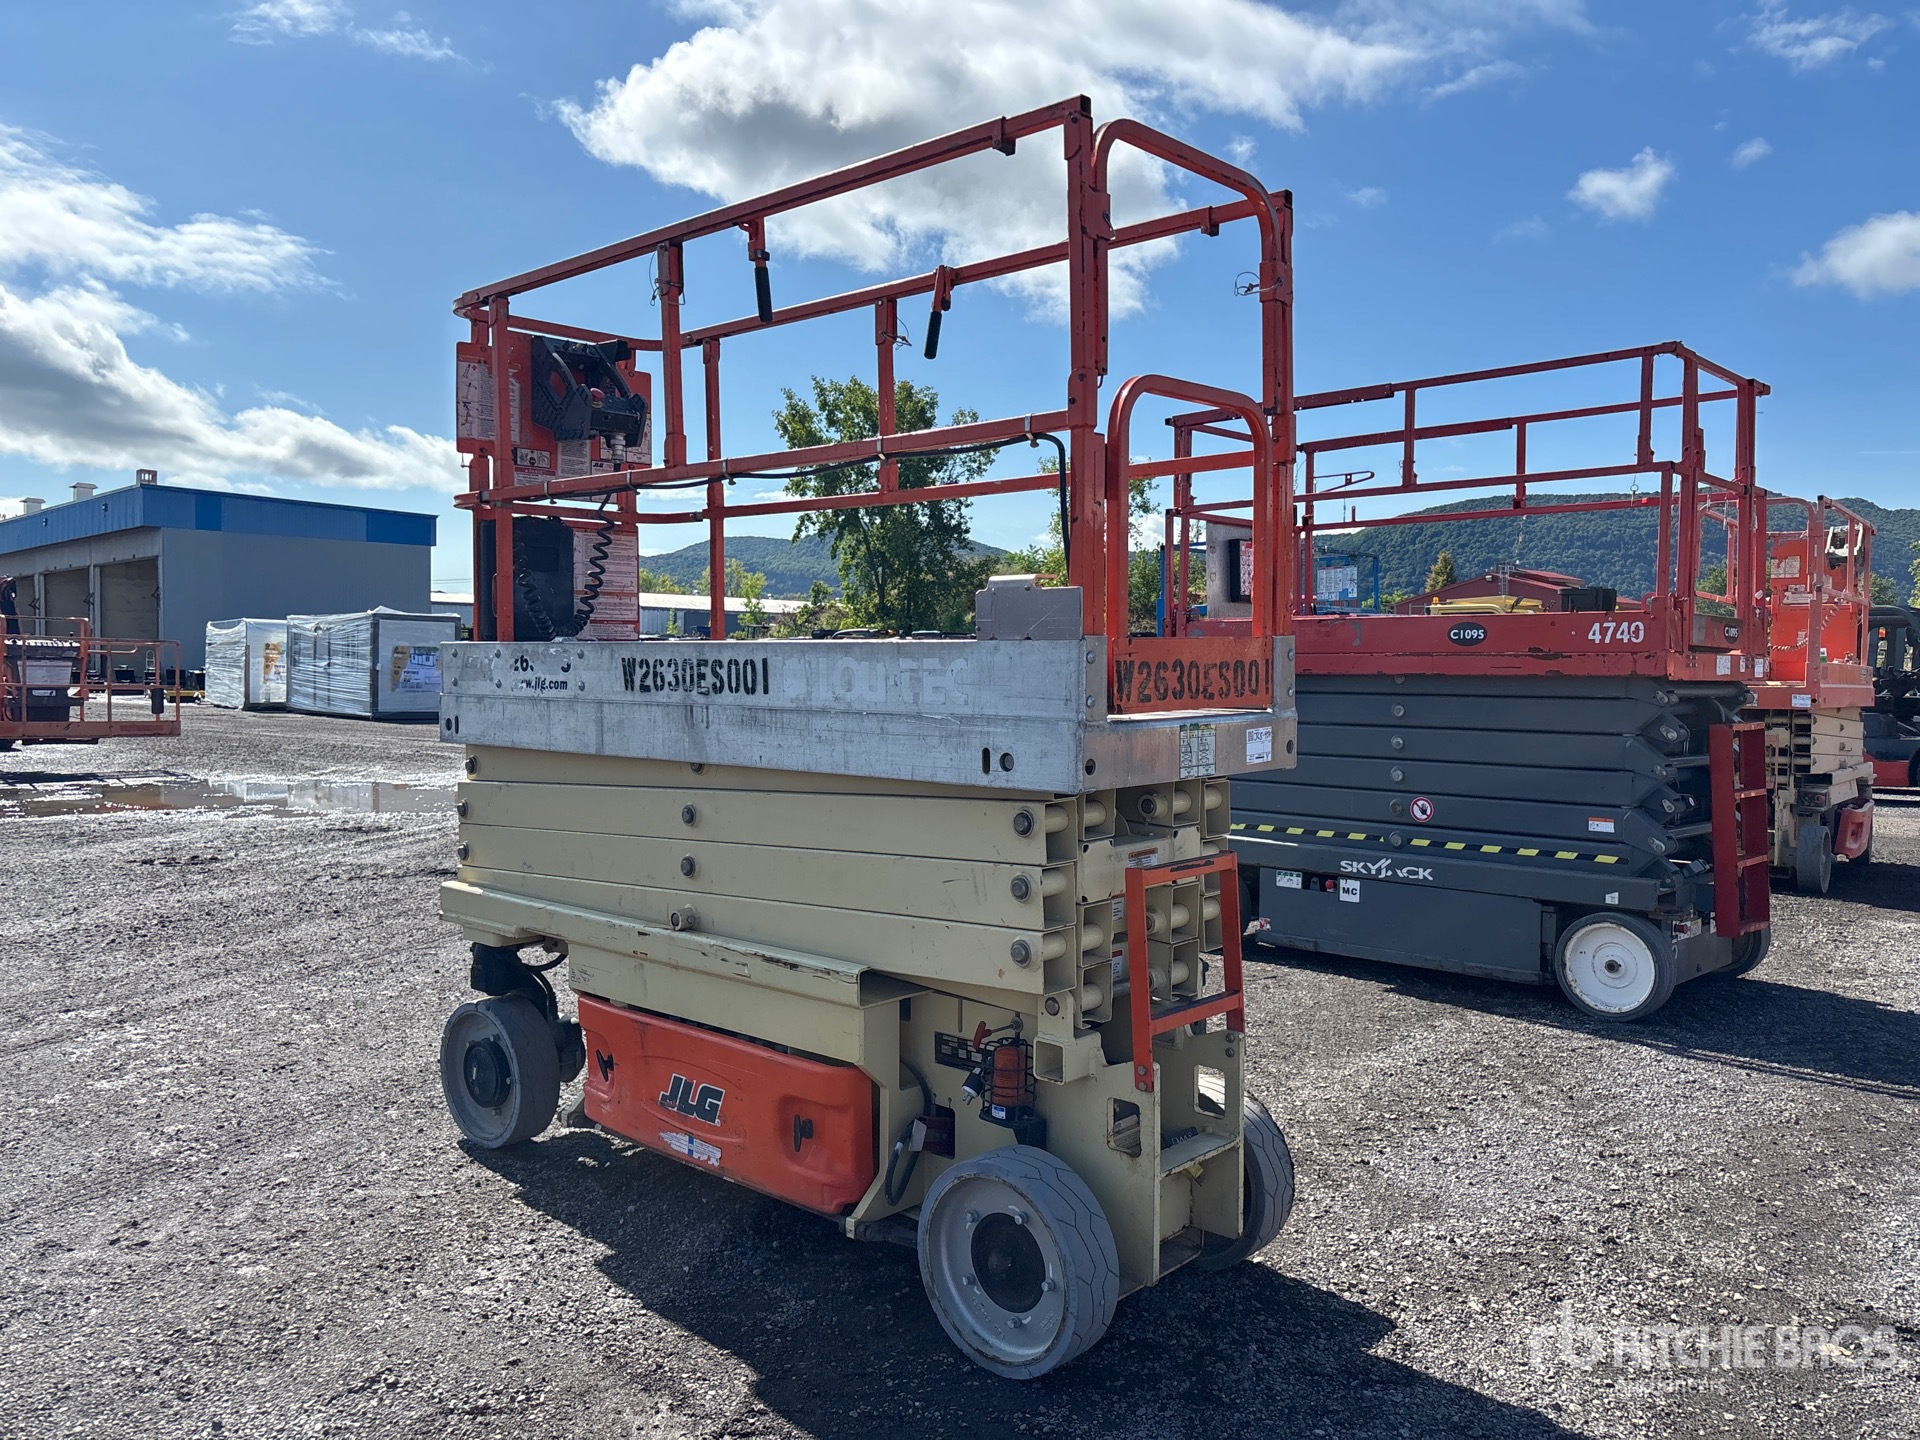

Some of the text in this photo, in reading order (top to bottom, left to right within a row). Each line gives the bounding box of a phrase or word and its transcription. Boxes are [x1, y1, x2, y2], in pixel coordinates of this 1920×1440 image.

[1450, 629, 1485, 640] C1095
[1588, 621, 1644, 644] 4740
[621, 656, 769, 695] W2630ES001
[1115, 658, 1270, 703] W2630ES001
[1340, 858, 1434, 881] SKYJACK
[658, 1073, 725, 1125] JLG
